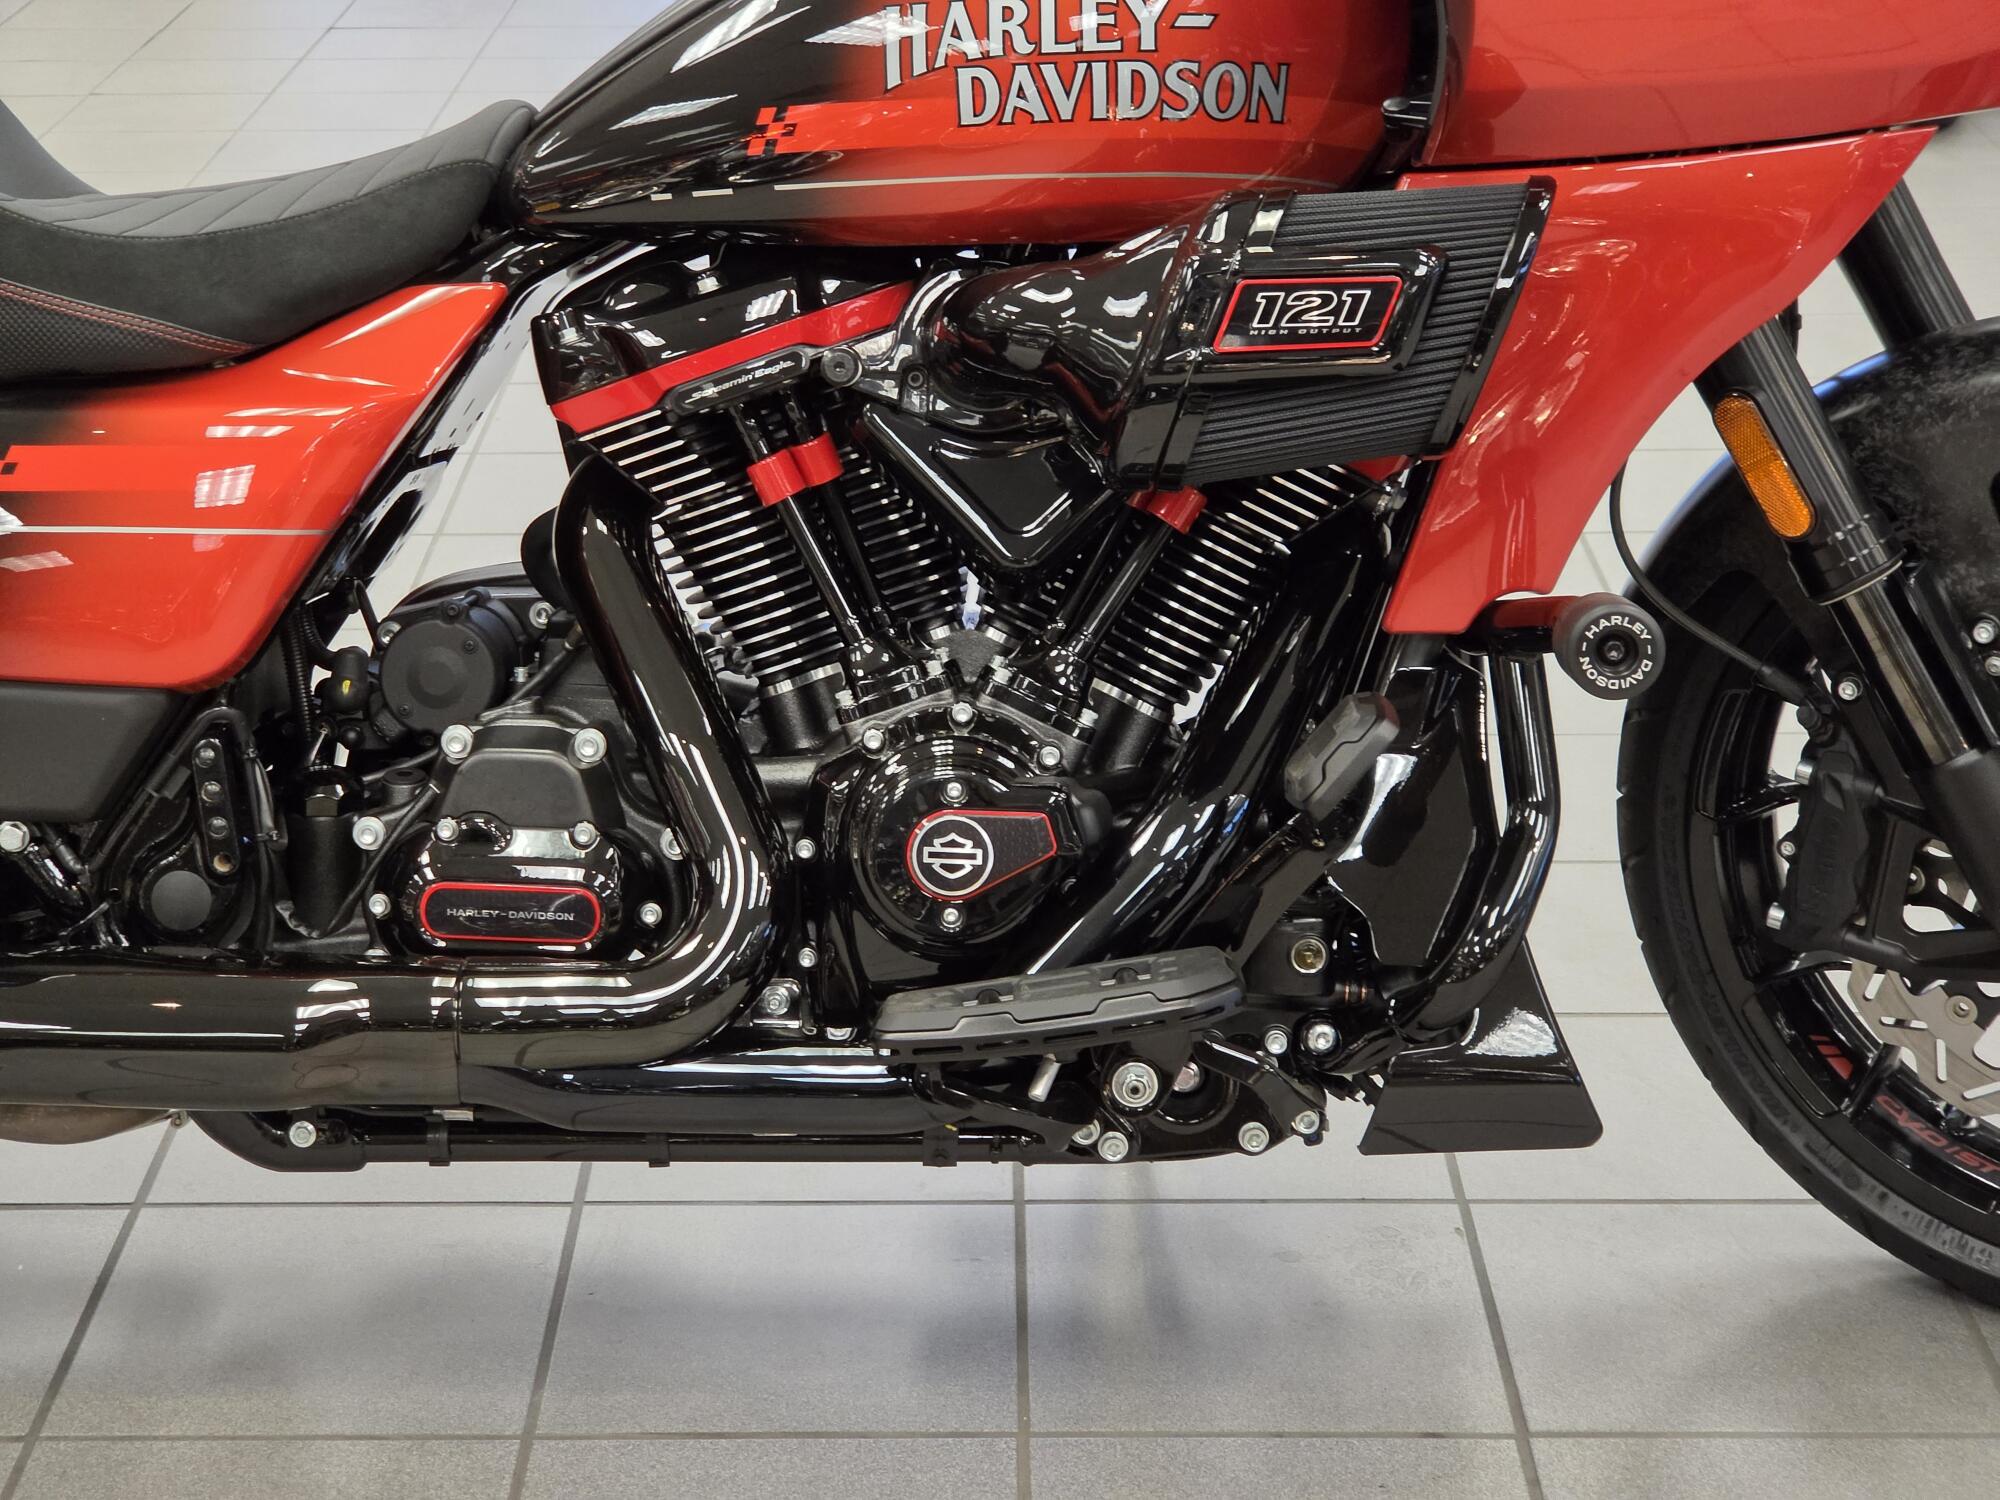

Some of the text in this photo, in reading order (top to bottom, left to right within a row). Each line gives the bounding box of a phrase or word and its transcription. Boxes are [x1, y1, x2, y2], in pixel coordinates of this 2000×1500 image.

[954, 60, 1291, 128] DAVIDSON
[1251, 289, 1372, 328] 121
[1249, 327, 1363, 336] HIGH OUTPUT
[1579, 615, 1653, 690] HARLEY DAVIDSON
[446, 908, 575, 922] HARLEY-DAVIDSON
